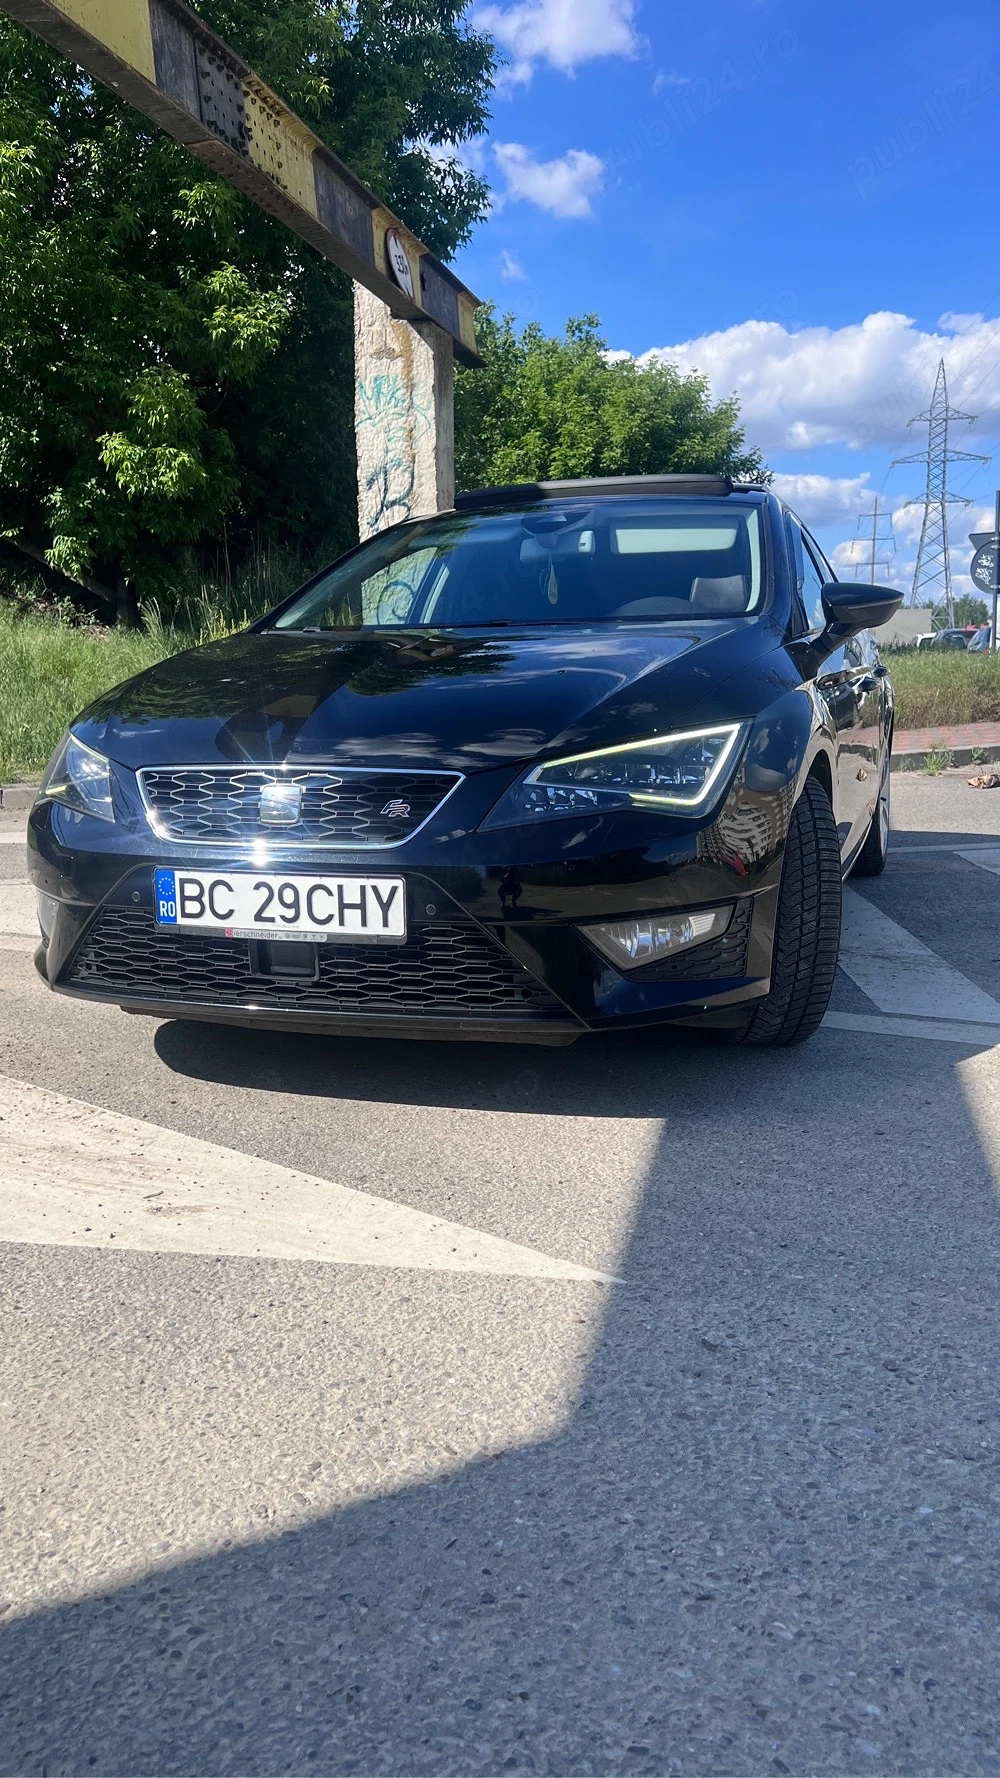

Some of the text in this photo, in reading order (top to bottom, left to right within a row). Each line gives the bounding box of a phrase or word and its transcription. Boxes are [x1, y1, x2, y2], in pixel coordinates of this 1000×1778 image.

[380, 799, 411, 818] FR
[178, 877, 235, 920] BC
[159, 900, 176, 918] RO
